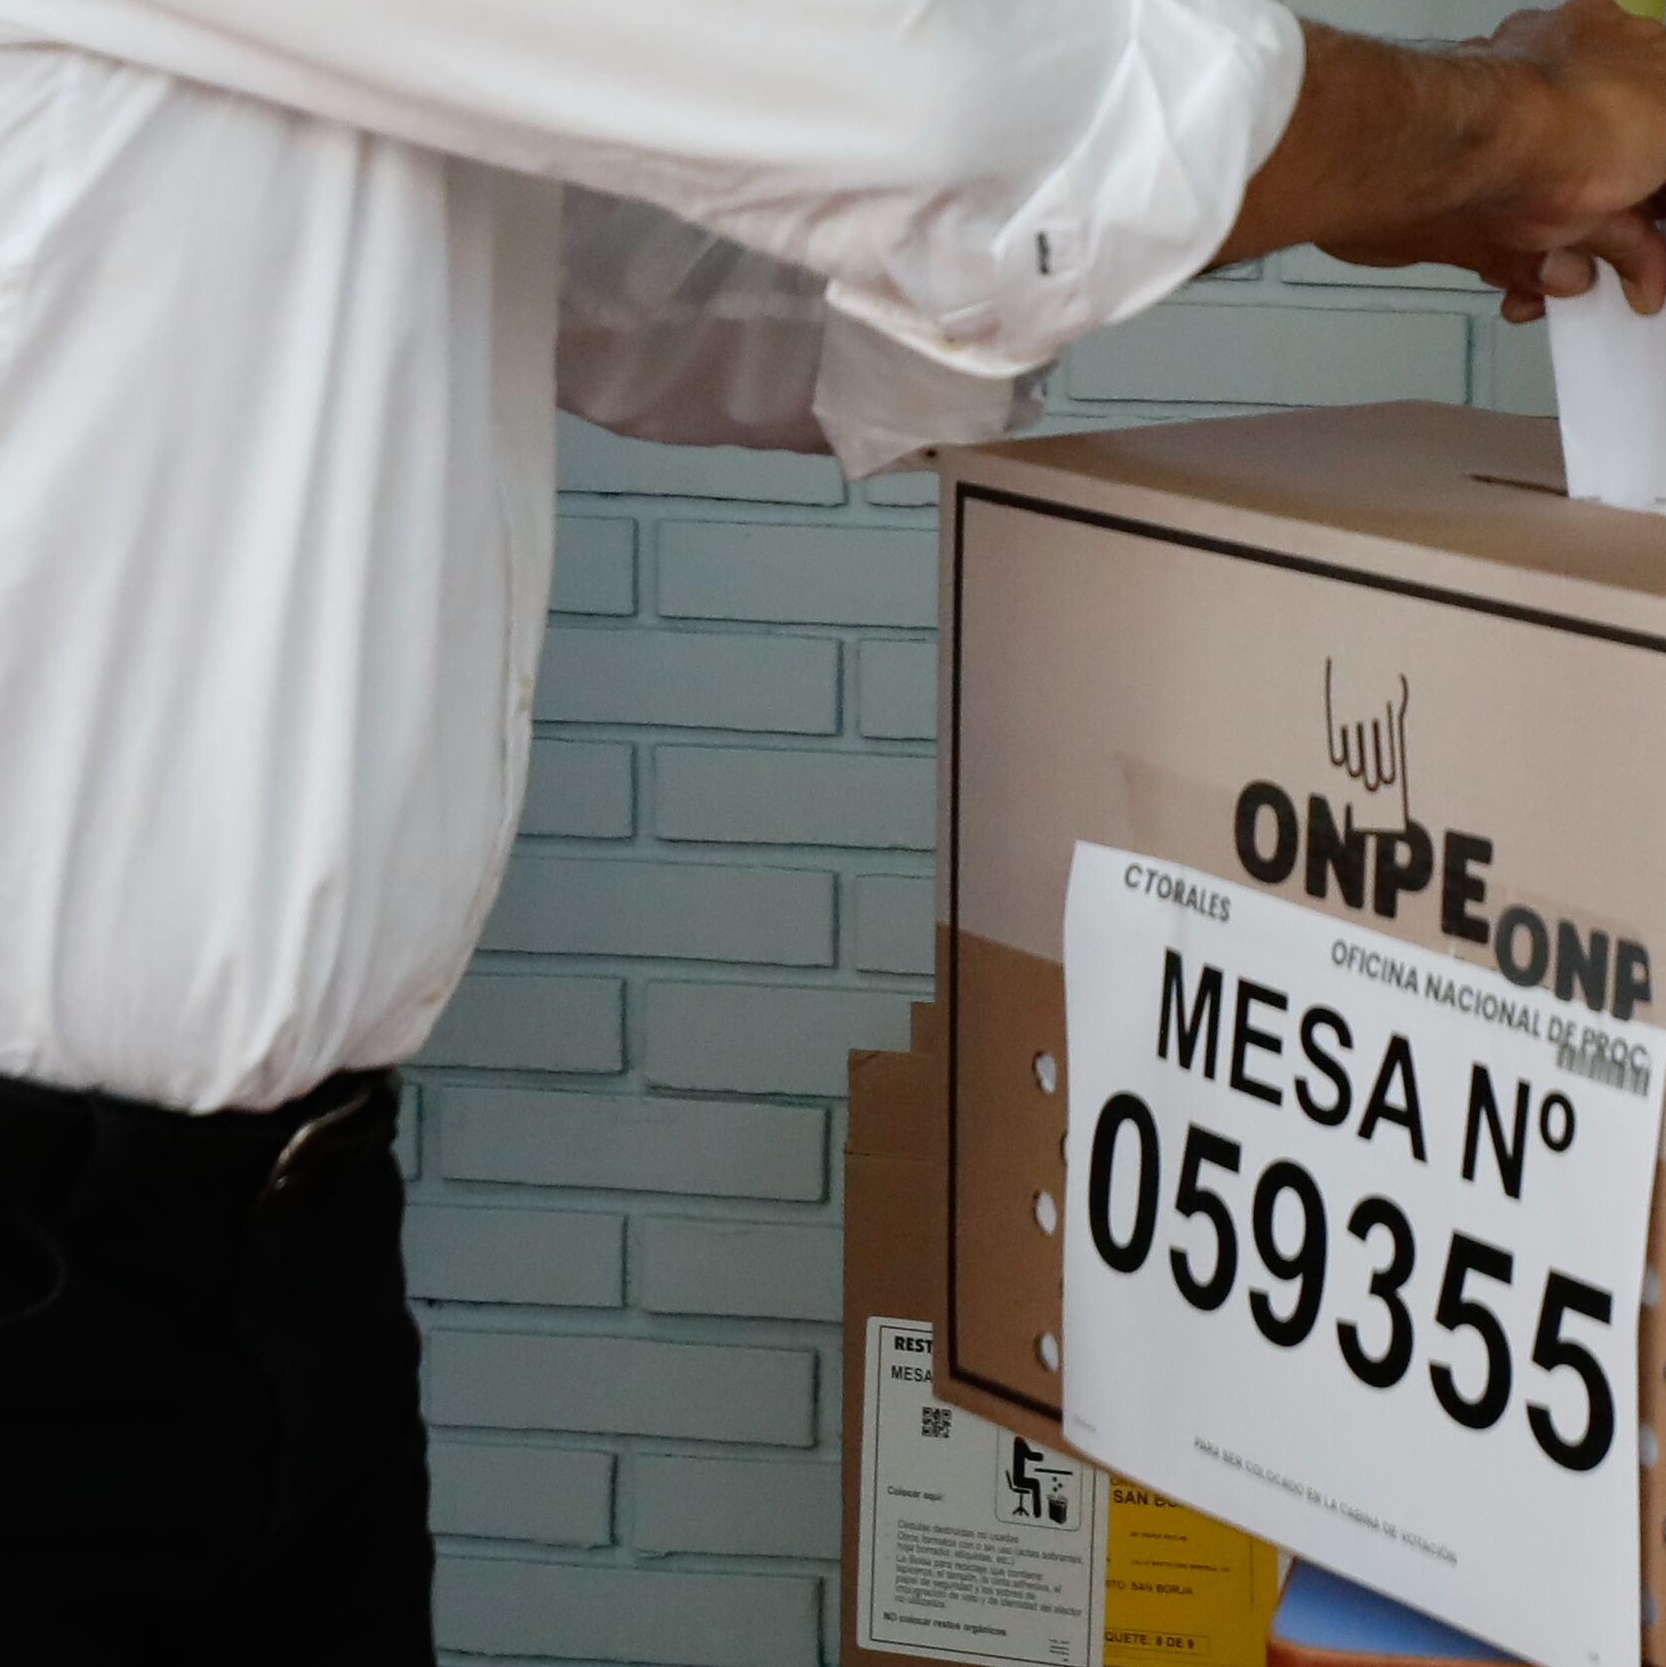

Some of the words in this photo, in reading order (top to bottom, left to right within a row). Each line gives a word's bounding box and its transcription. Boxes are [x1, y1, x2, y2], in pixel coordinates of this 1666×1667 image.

[1124, 863, 1232, 923] CTORALES
[1234, 779, 1495, 944] ONPE
[1331, 939, 1421, 998] OFICINA
[1424, 973, 1542, 1041] NACIONAL
[1547, 1014, 1579, 1050] DE
[1157, 950, 1427, 1163] MESA
[1461, 1065, 1576, 1200] Nº
[1088, 1092, 1615, 1473] 059355
[890, 1365, 932, 1383] MESA
[893, 1335, 933, 1353] REST
[1113, 1489, 1149, 1506] SAN
